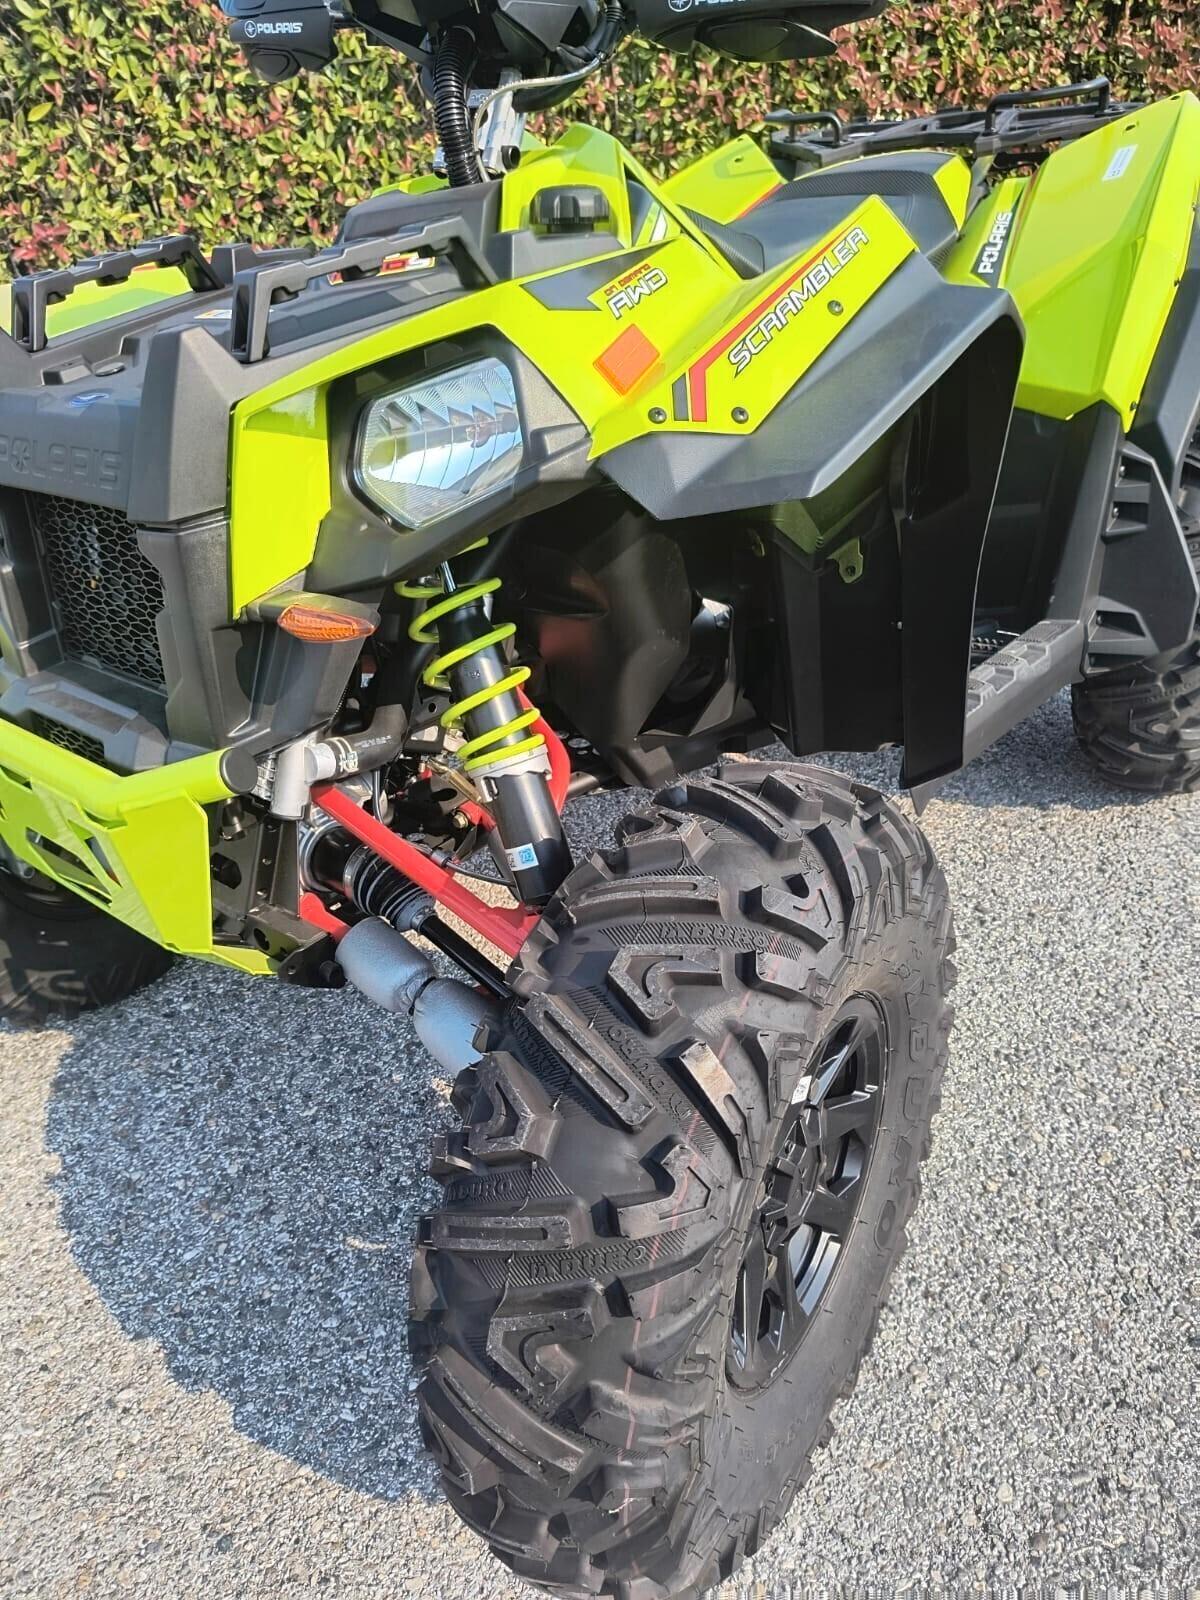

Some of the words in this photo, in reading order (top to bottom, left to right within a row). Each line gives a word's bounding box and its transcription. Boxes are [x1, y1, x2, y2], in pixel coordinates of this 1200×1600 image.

[257, 22, 303, 34] POLARIS
[978, 211, 1013, 274] POLARIS
[607, 267, 668, 320] AWD
[728, 227, 869, 378] SCRAMBLER
